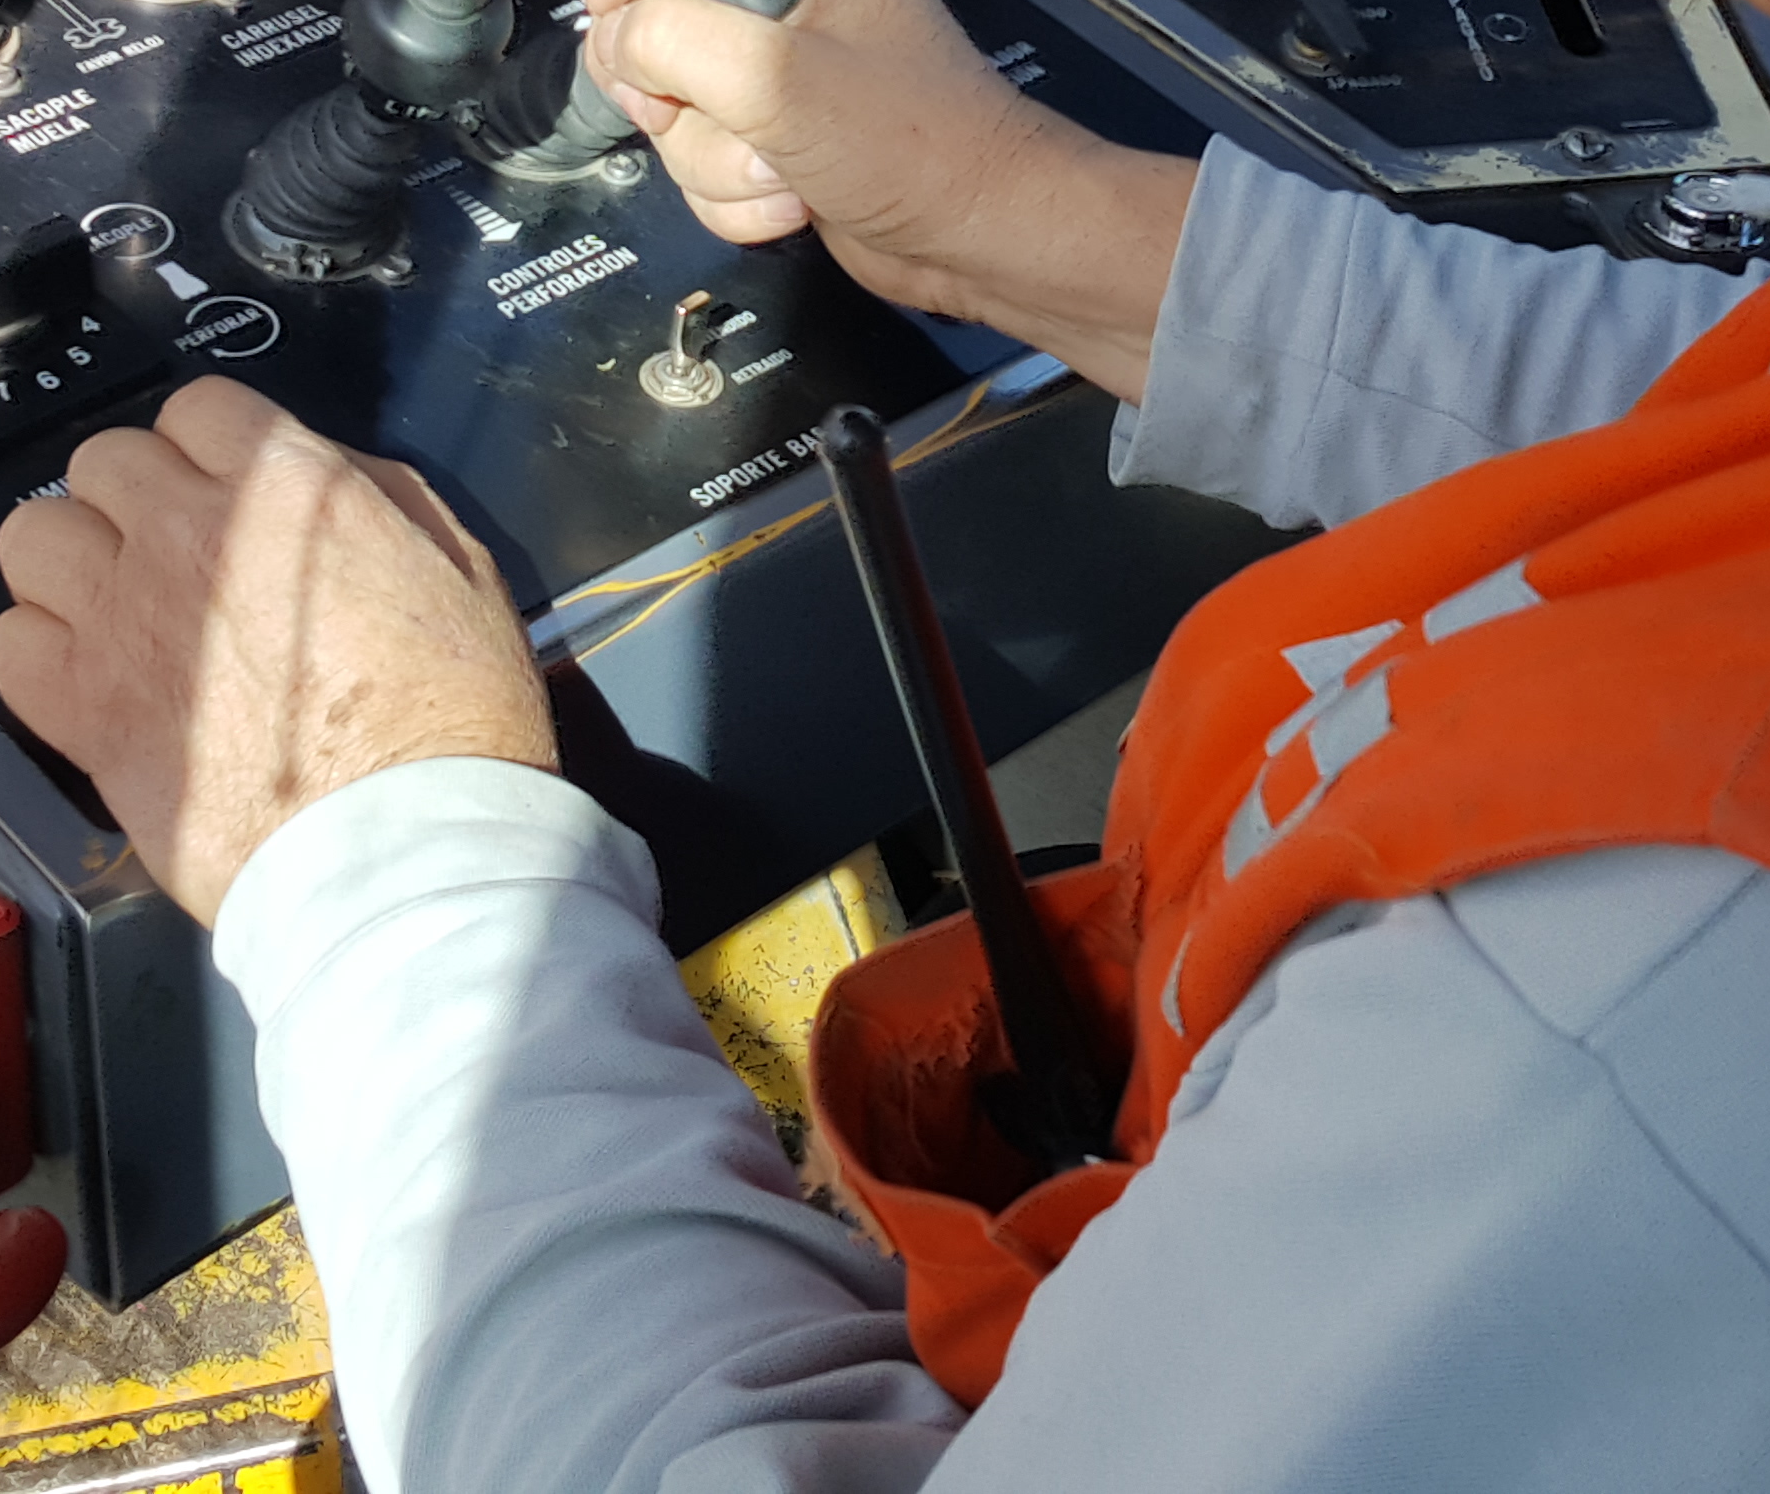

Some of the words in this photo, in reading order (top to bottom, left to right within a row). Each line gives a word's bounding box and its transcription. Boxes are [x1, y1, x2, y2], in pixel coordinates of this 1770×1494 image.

[220, 4, 329, 50] CARRUSEL
[6, 115, 92, 154] MUELA
[487, 233, 607, 296] CONTROLES
[497, 246, 640, 319] PERFORACION
[81, 315, 102, 333] 4
[174, 307, 263, 352] PERFORAR
[66, 345, 92, 366] 5
[731, 348, 794, 385] RETRAIDO
[36, 370, 61, 390] 6
[689, 448, 789, 508] SOPORTE
